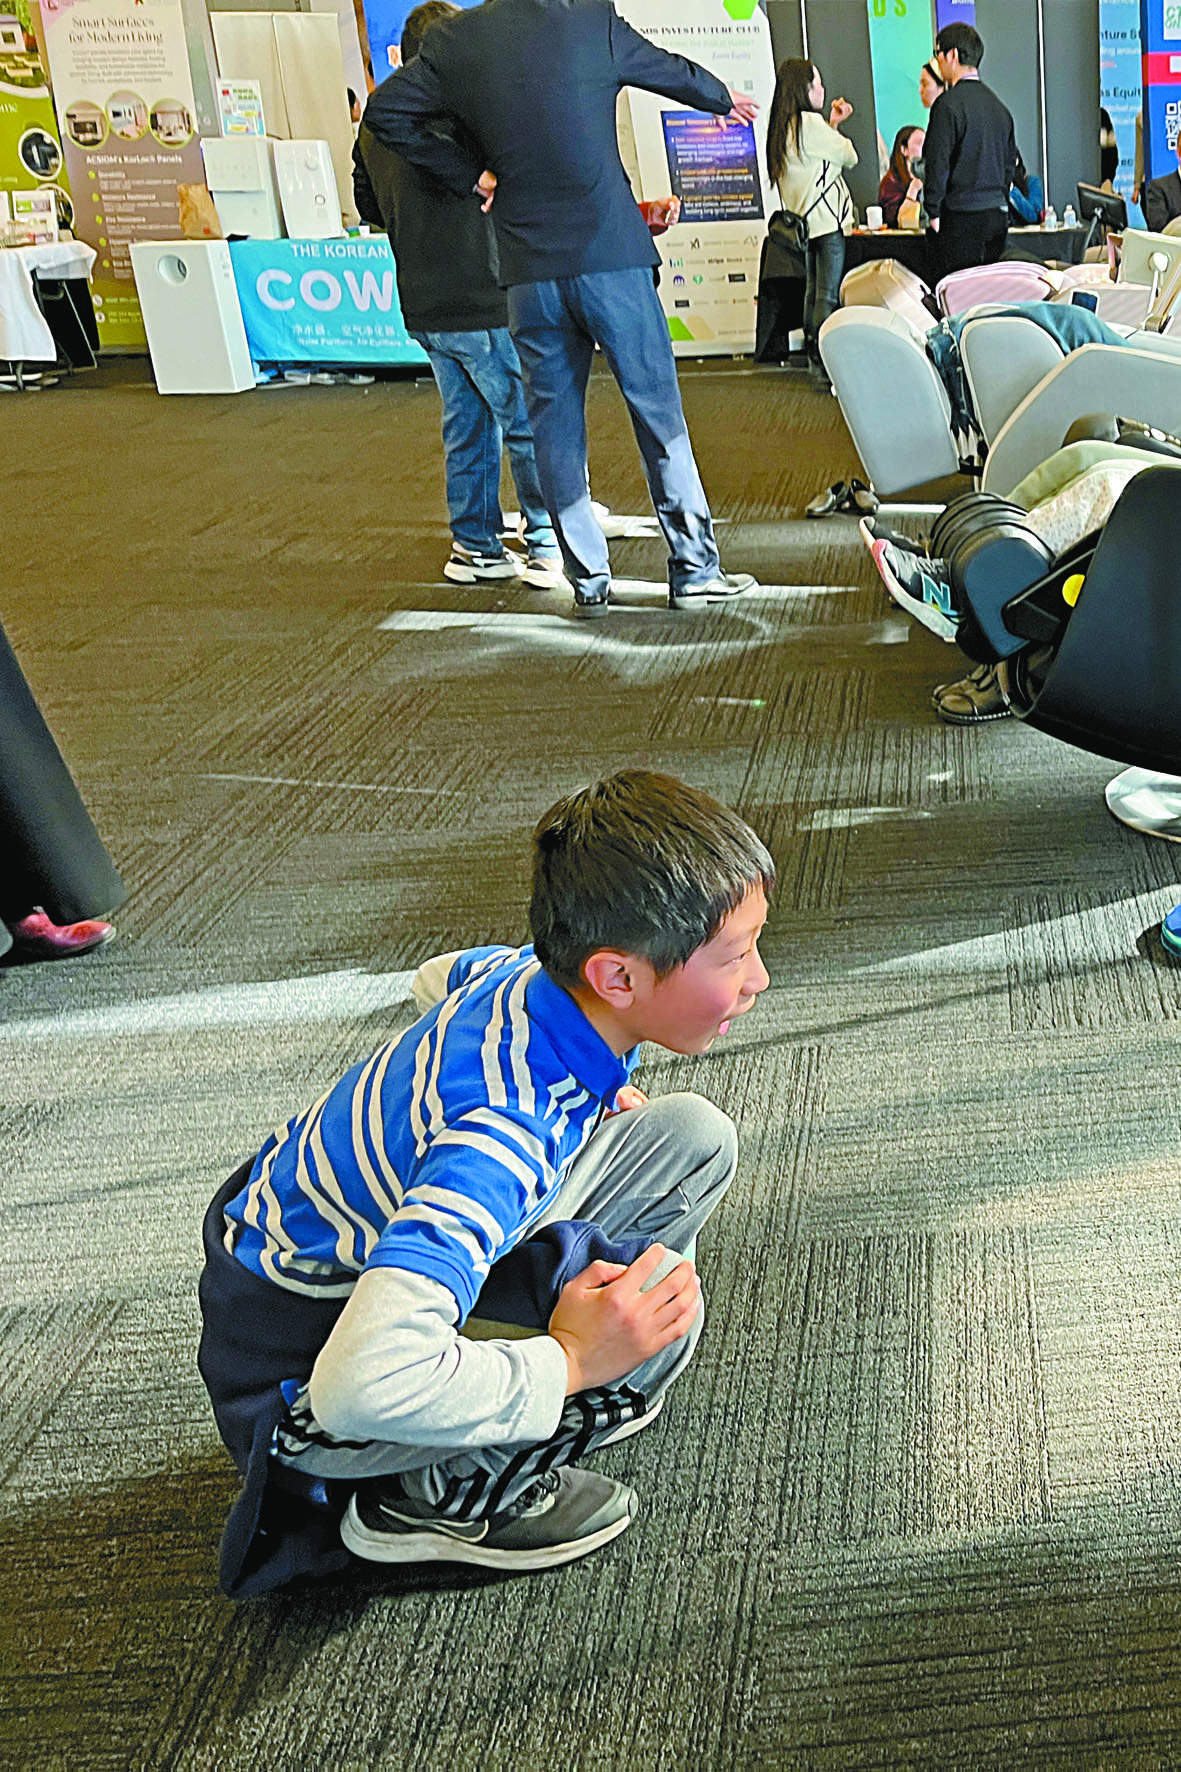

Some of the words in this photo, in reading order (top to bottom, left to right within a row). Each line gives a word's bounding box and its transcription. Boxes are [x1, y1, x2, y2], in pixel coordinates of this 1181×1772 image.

[72, 16, 105, 28] Smart
[697, 25, 732, 35] FUTURE
[736, 25, 761, 34] CLUB
[290, 244, 321, 258] THE
[325, 244, 389, 259] KOREAN
